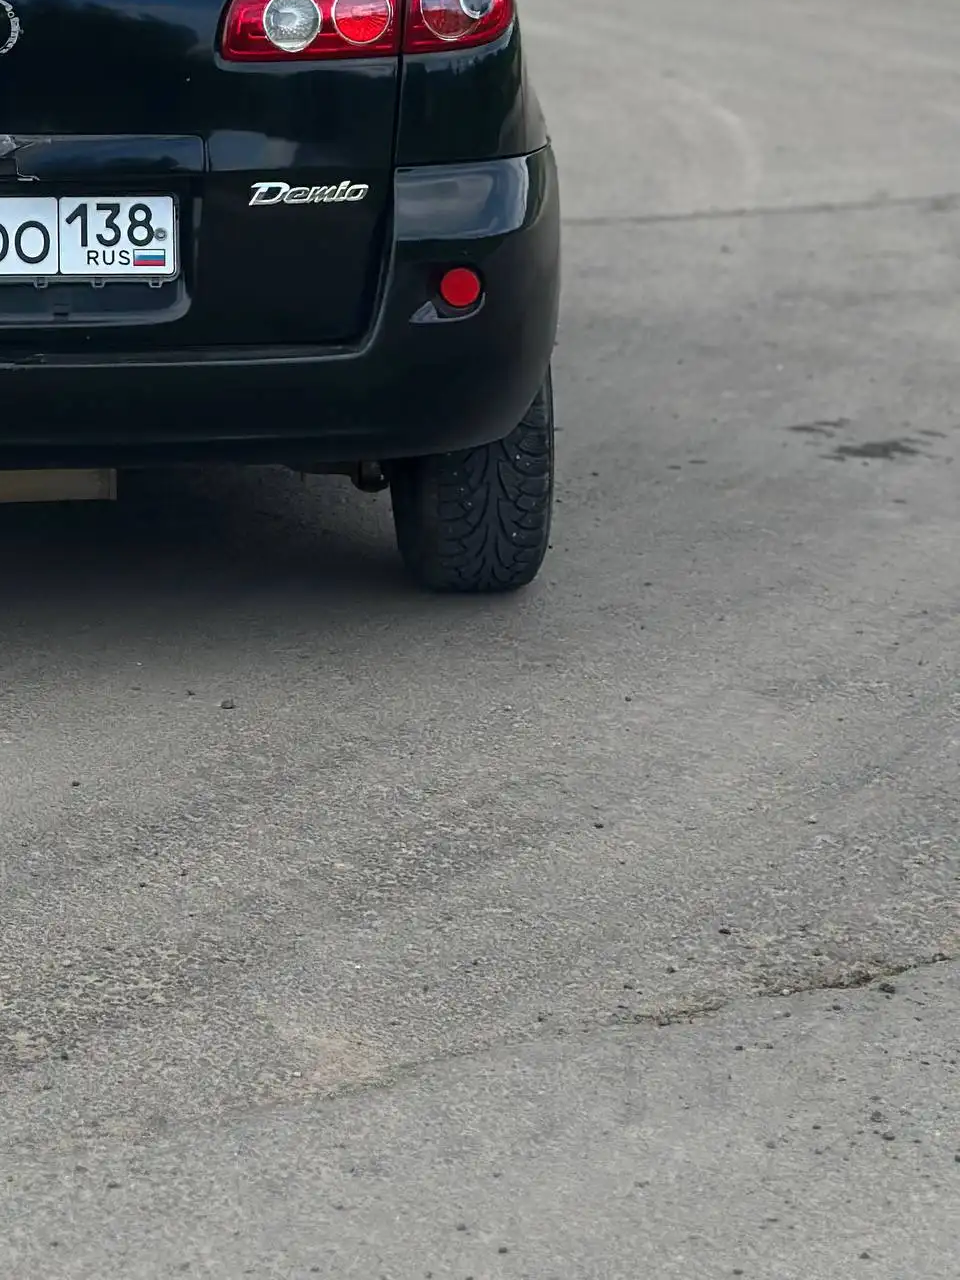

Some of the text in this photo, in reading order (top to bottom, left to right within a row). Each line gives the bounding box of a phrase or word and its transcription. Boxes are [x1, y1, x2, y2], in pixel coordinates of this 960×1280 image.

[248, 180, 369, 206] Demio
[65, 202, 155, 247] 138
[87, 249, 130, 266] RUS
